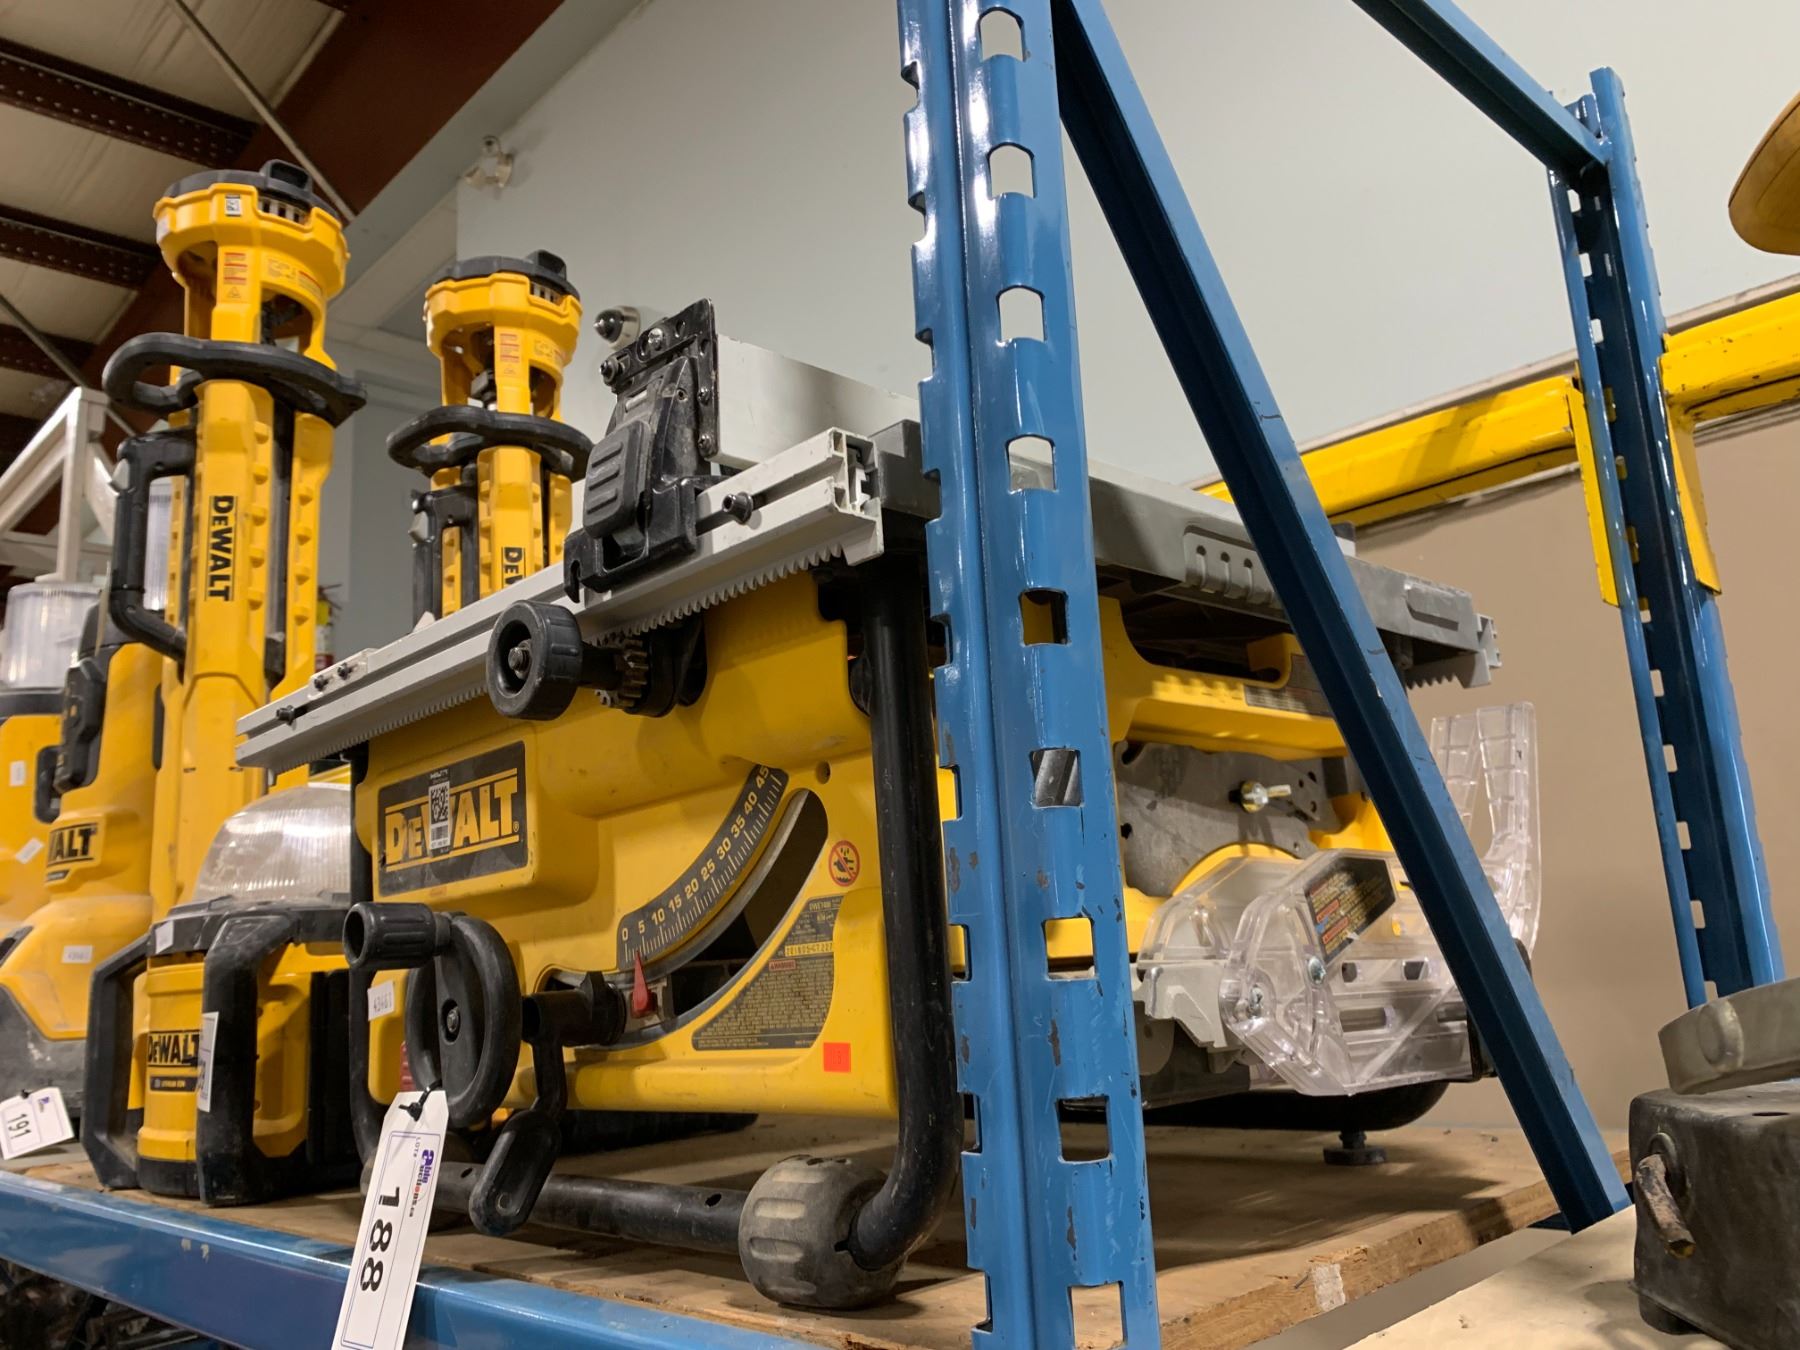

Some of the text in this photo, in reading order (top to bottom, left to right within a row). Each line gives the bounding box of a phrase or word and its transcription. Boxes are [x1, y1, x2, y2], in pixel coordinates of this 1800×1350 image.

[208, 496, 234, 601] DEWALT
[621, 767, 769, 942] 0 5 10 15 20 25 30 35 40 45
[8, 1113, 31, 1139] 191
[360, 1186, 400, 1292] 188
